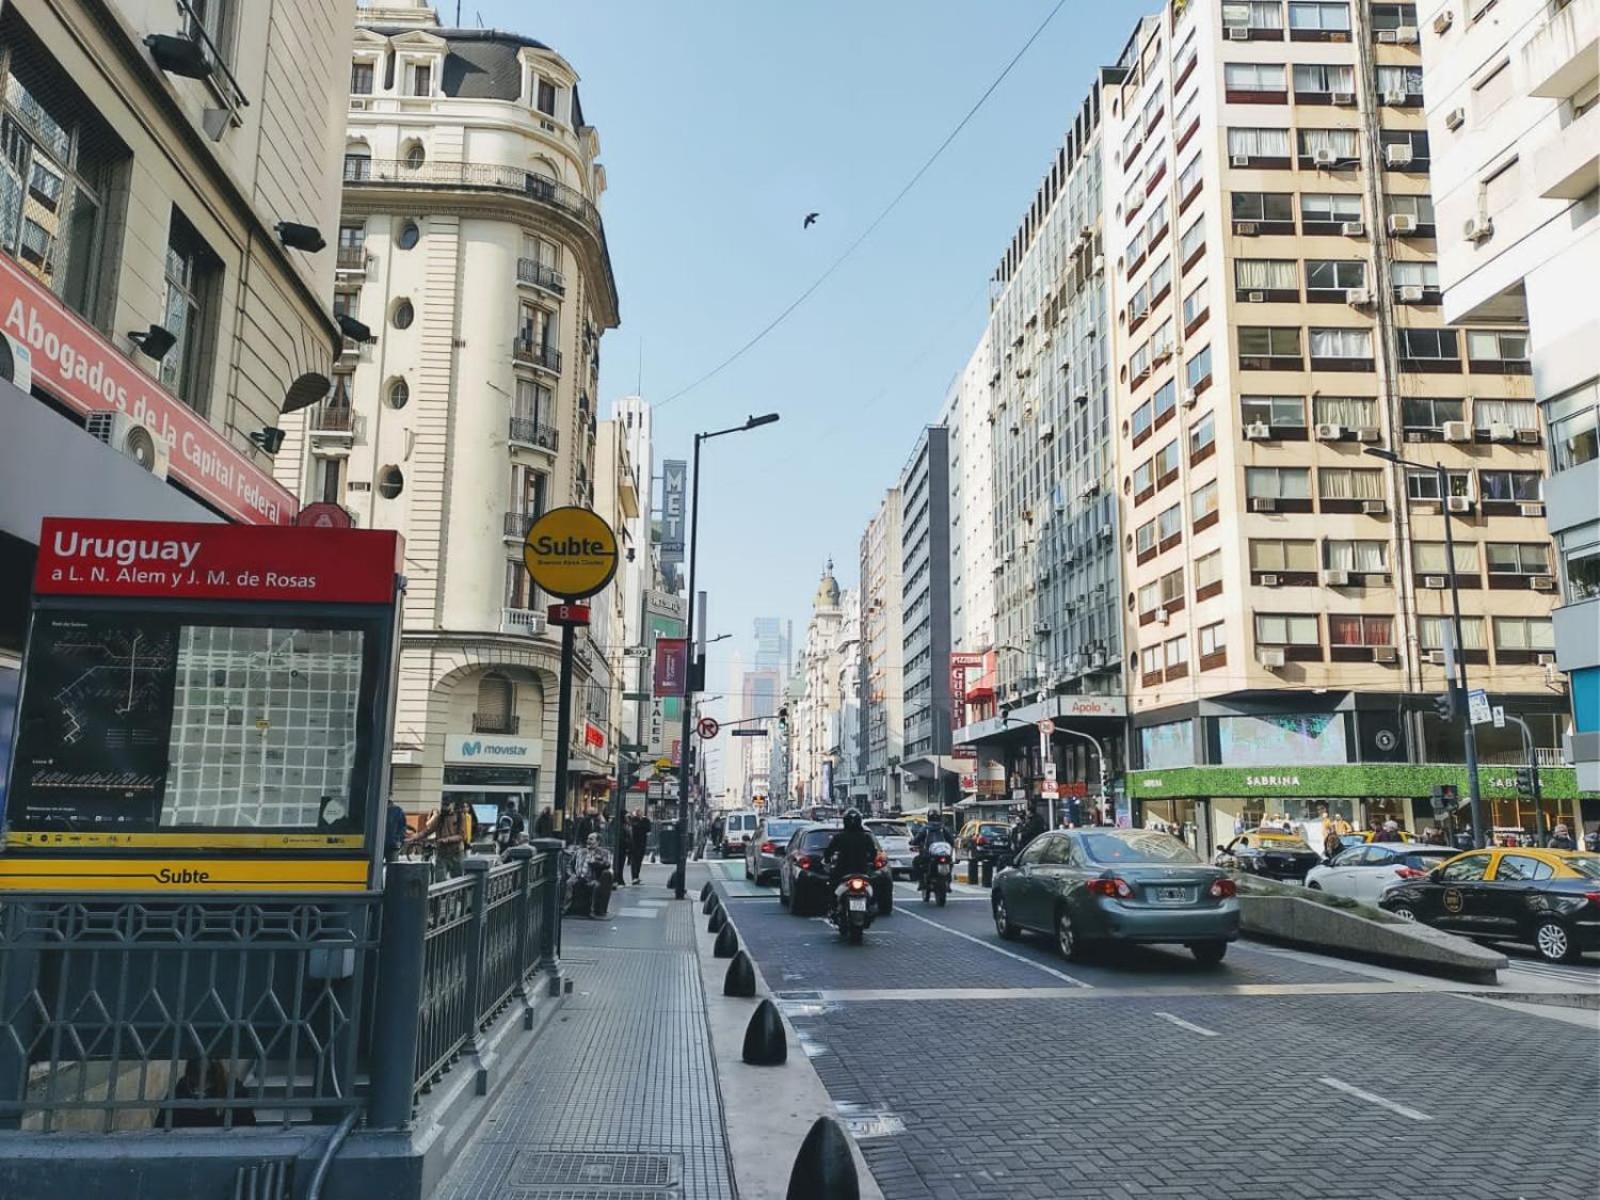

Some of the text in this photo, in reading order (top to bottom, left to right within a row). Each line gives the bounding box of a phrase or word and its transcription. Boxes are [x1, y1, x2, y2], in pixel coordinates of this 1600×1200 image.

[5, 296, 280, 523] Abogados de la Capital Federal
[53, 530, 201, 567] Uruguay
[538, 536, 604, 556] Subte
[52, 568, 316, 588] a L. N. Alem y J. M. de Rosas
[560, 607, 569, 619] B
[1072, 702, 1101, 713] Apolo
[483, 743, 528, 756] movistar
[1246, 776, 1300, 787] SABRINA
[159, 869, 209, 885] Subte
